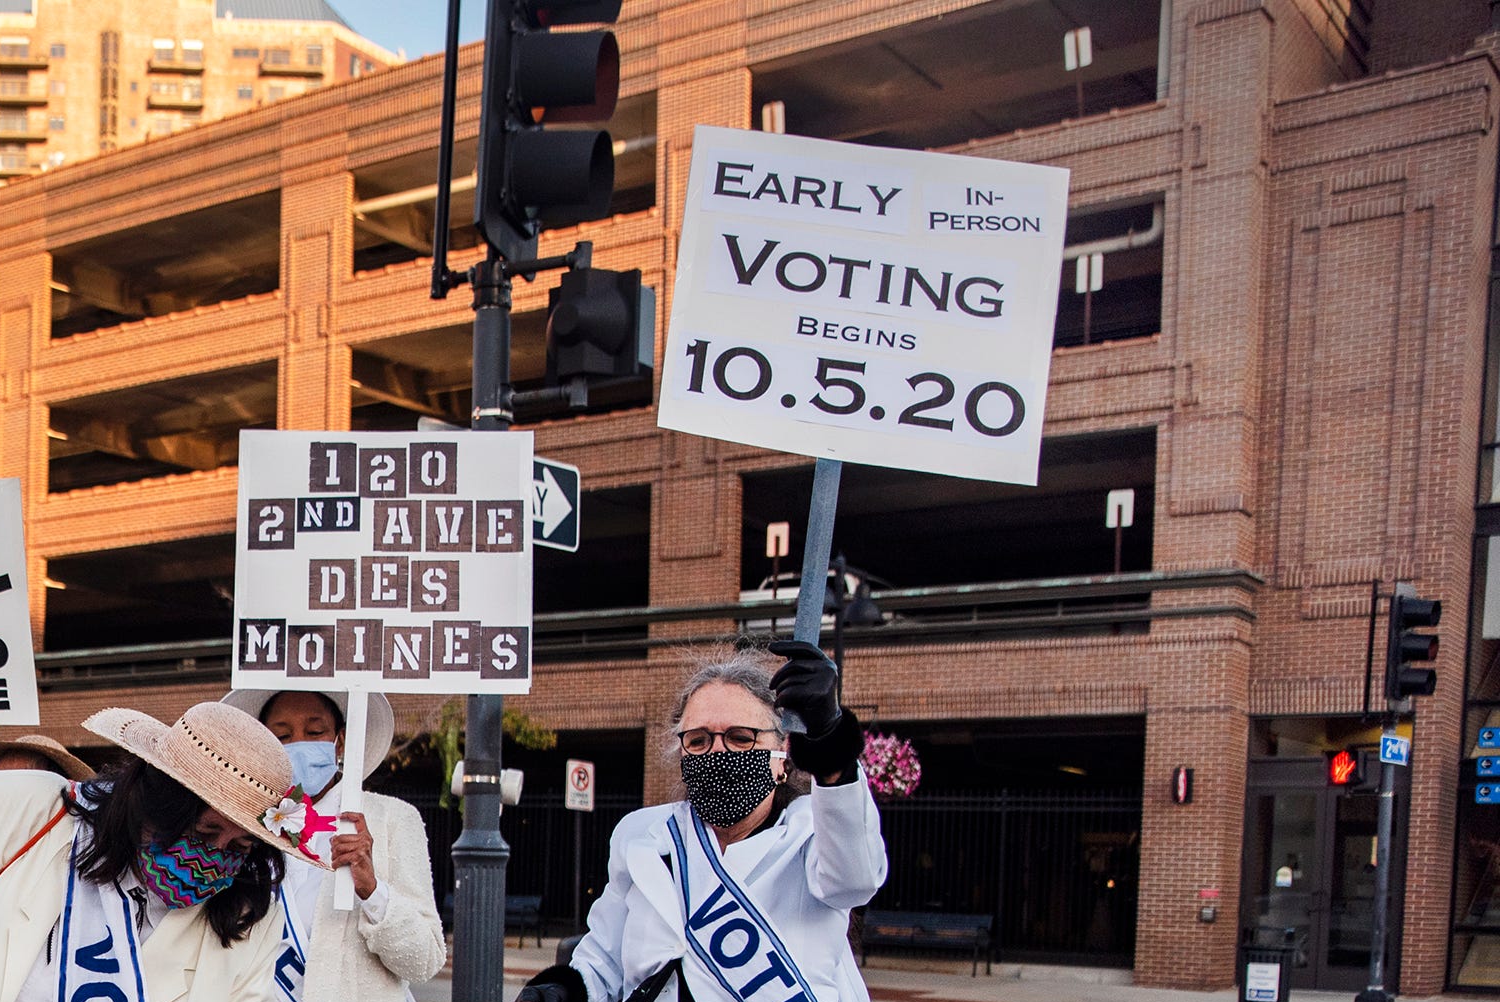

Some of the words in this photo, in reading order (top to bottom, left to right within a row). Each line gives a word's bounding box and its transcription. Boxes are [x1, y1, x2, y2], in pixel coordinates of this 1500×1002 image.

[686, 338, 1026, 437] 10.5.20
[324, 448, 447, 492] 120
[383, 505, 513, 545] AVE
[320, 563, 448, 605] DES
[244, 624, 519, 671] MOINES
